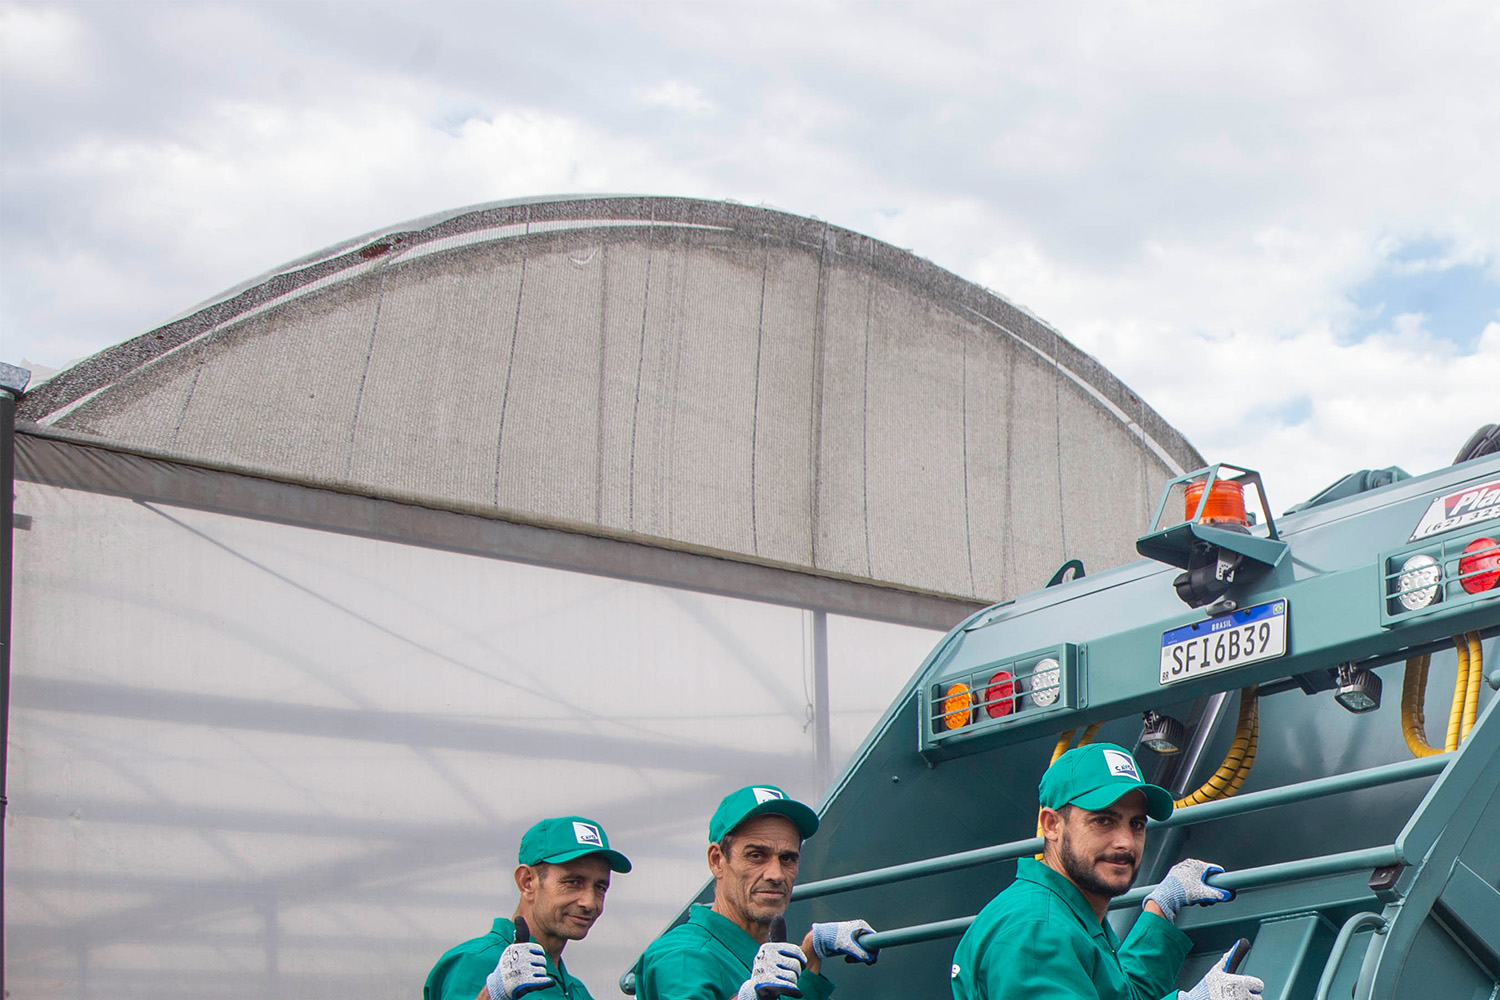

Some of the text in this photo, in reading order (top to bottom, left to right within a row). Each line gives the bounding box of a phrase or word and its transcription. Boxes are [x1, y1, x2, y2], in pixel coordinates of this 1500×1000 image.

[1425, 516, 1462, 534] (62)
[1211, 620, 1232, 632] BRASIL
[1171, 622, 1271, 675] SFI6B39
[1162, 671, 1169, 682] BR
